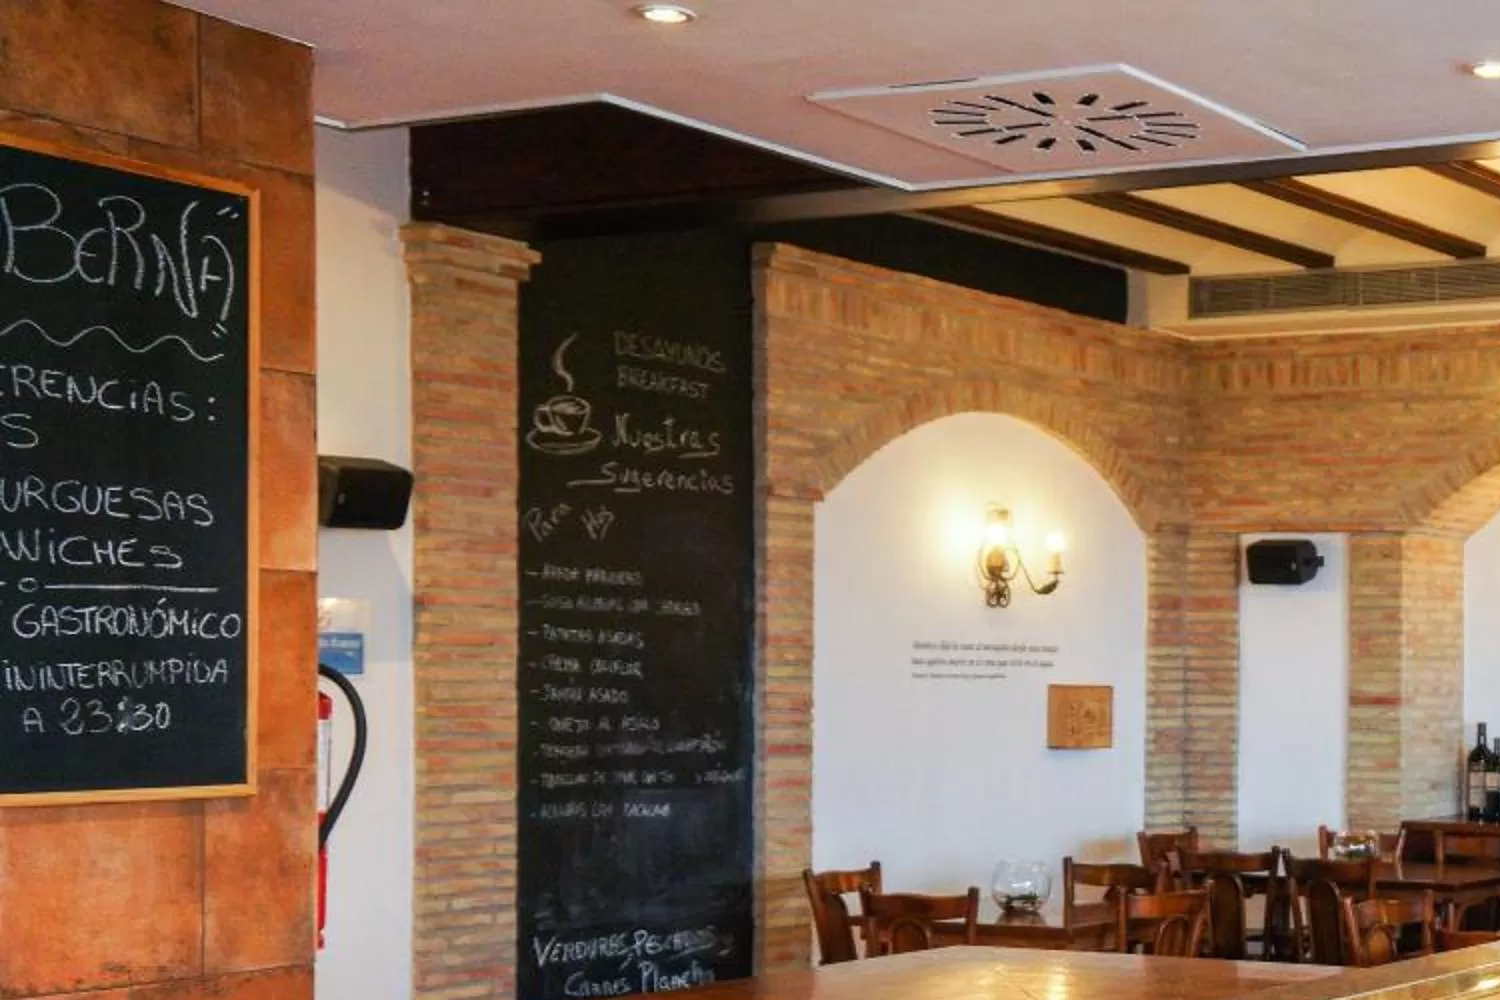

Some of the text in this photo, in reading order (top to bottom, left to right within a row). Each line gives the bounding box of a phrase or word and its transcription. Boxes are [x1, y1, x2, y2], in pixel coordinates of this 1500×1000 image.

[616, 364, 711, 399] BREAKFAST
[23, 697, 173, 735] A 23:30
